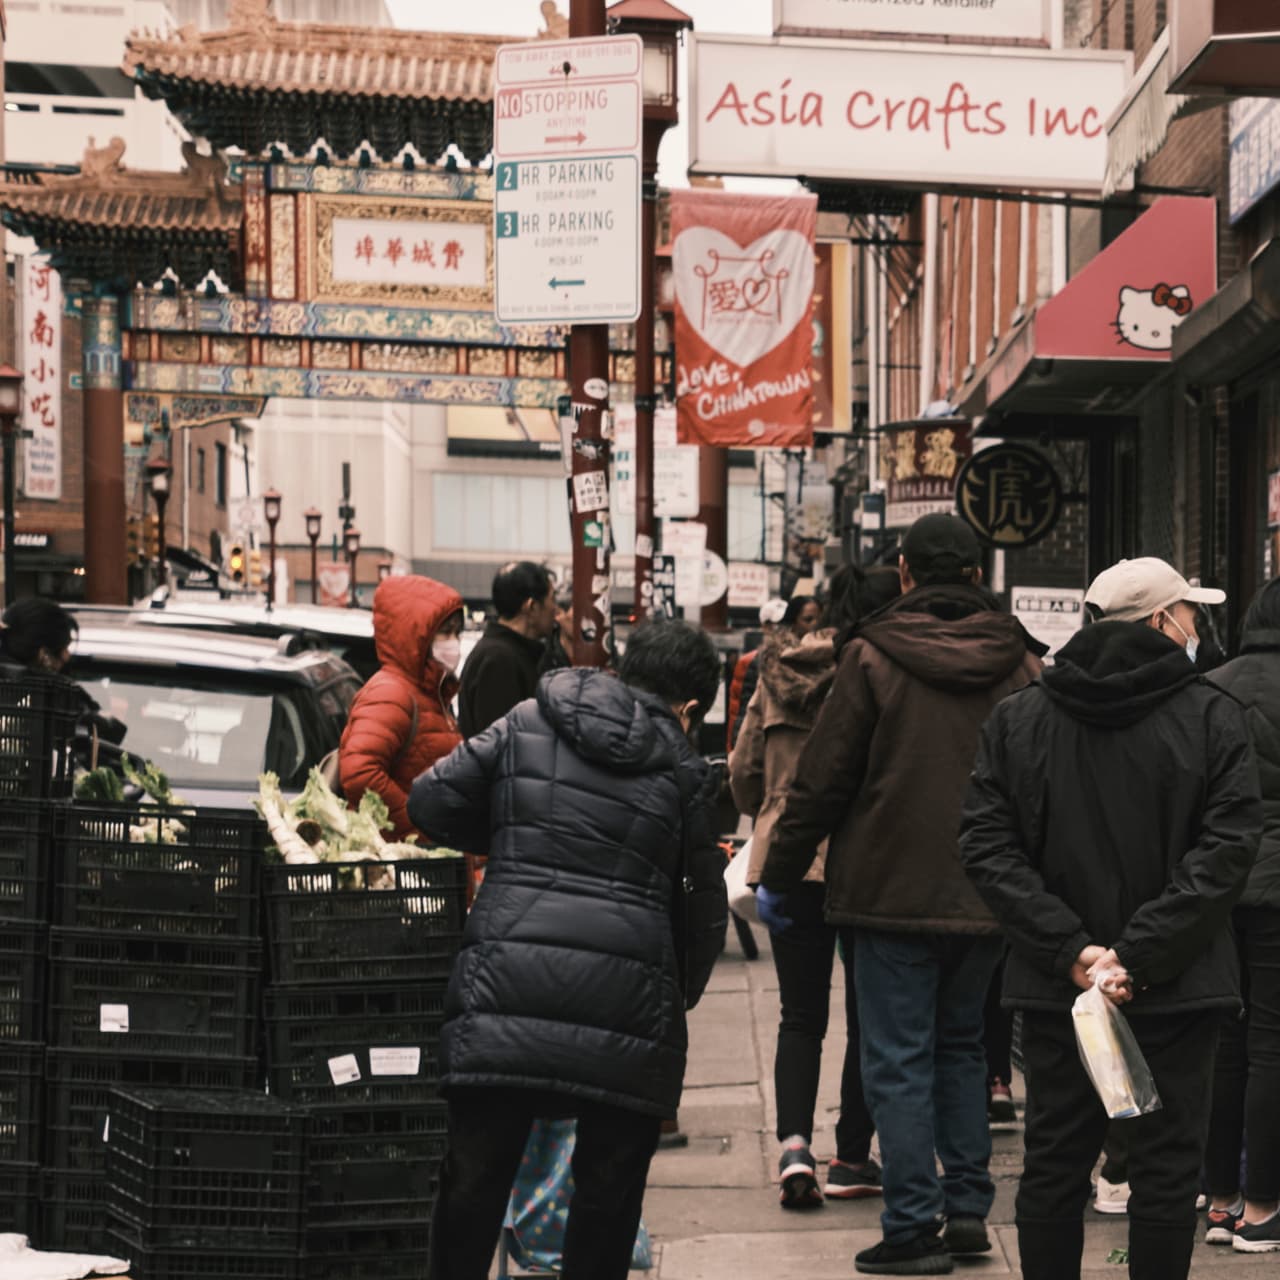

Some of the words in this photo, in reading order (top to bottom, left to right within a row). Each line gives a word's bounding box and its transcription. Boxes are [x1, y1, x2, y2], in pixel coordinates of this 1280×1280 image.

[501, 93, 521, 118] NO
[525, 88, 609, 114] STOPPING
[706, 79, 824, 128] Asia
[847, 82, 1006, 150] Crafts
[1029, 97, 1102, 138] Inc
[503, 166, 513, 189] 2
[522, 165, 541, 186] HR
[549, 161, 615, 185] PARKING
[503, 213, 513, 236] 3
[522, 213, 541, 234] HR
[549, 210, 615, 232] PARKING
[29, 264, 56, 428] 河南小吃
[697, 368, 811, 421] CHINATOWN
